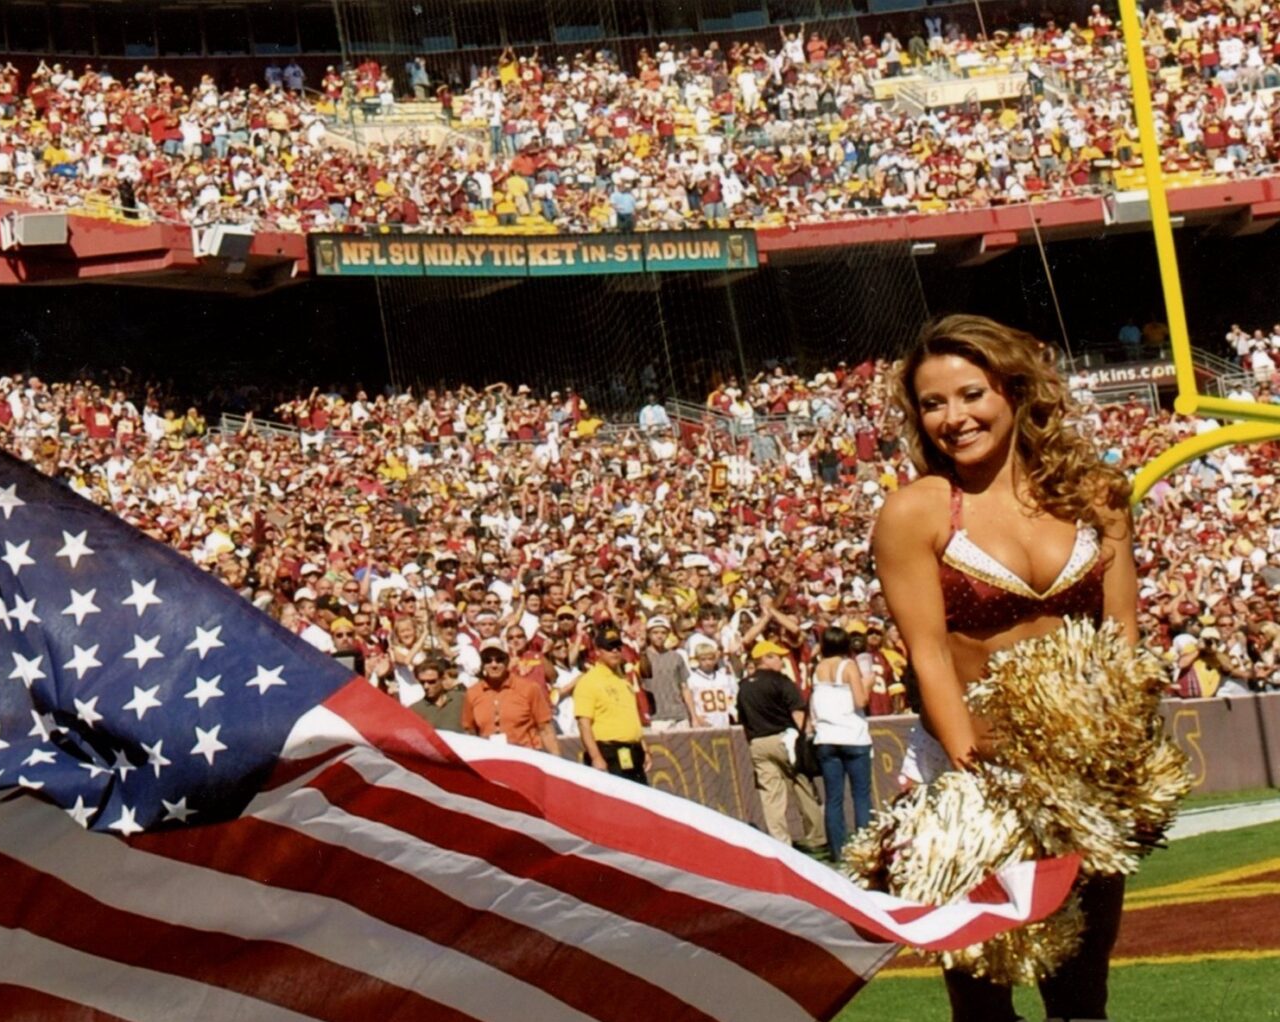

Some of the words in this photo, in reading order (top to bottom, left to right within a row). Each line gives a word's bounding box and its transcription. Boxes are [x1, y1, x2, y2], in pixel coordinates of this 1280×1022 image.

[341, 241, 387, 265] NFL
[388, 241, 486, 266] SUNDAY
[487, 241, 578, 266] TICKET
[582, 240, 721, 263] IN-STADIUM
[700, 689, 727, 713] 89
